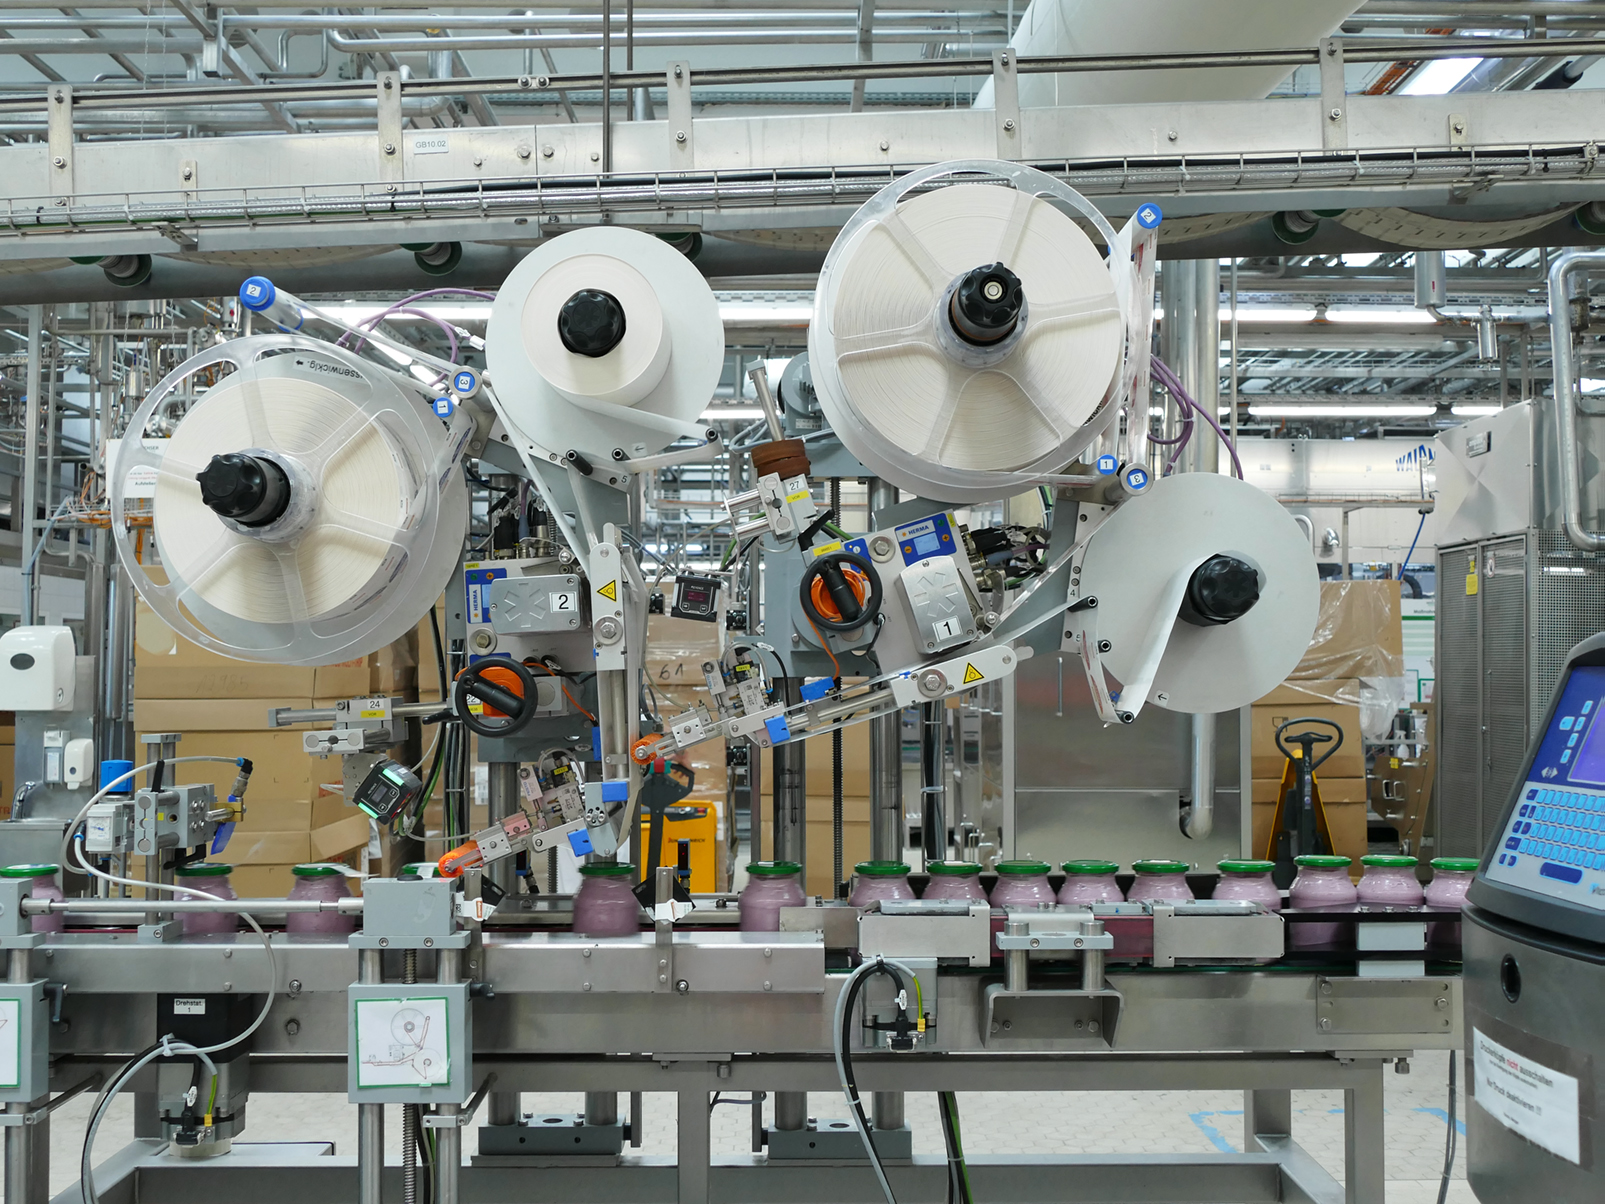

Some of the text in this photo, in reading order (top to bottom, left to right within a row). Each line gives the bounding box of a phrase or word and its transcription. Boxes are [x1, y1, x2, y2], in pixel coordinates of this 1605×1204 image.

[415, 140, 447, 148] GB10.02
[1144, 211, 1152, 220] 2
[249, 286, 257, 295] 2
[459, 378, 469, 386] 3
[621, 475, 628, 484] 5
[1133, 474, 1141, 483] 3
[789, 480, 800, 491] 27
[908, 525, 930, 535] HERMA
[1069, 589, 1076, 597] 4
[558, 594, 569, 610] 2
[943, 621, 952, 636] 1
[369, 700, 381, 709] 24
[175, 999, 204, 1007] Drehstat.
[1506, 1057, 1519, 1071] nicht
[1519, 1066, 1553, 1088] ausschalten
